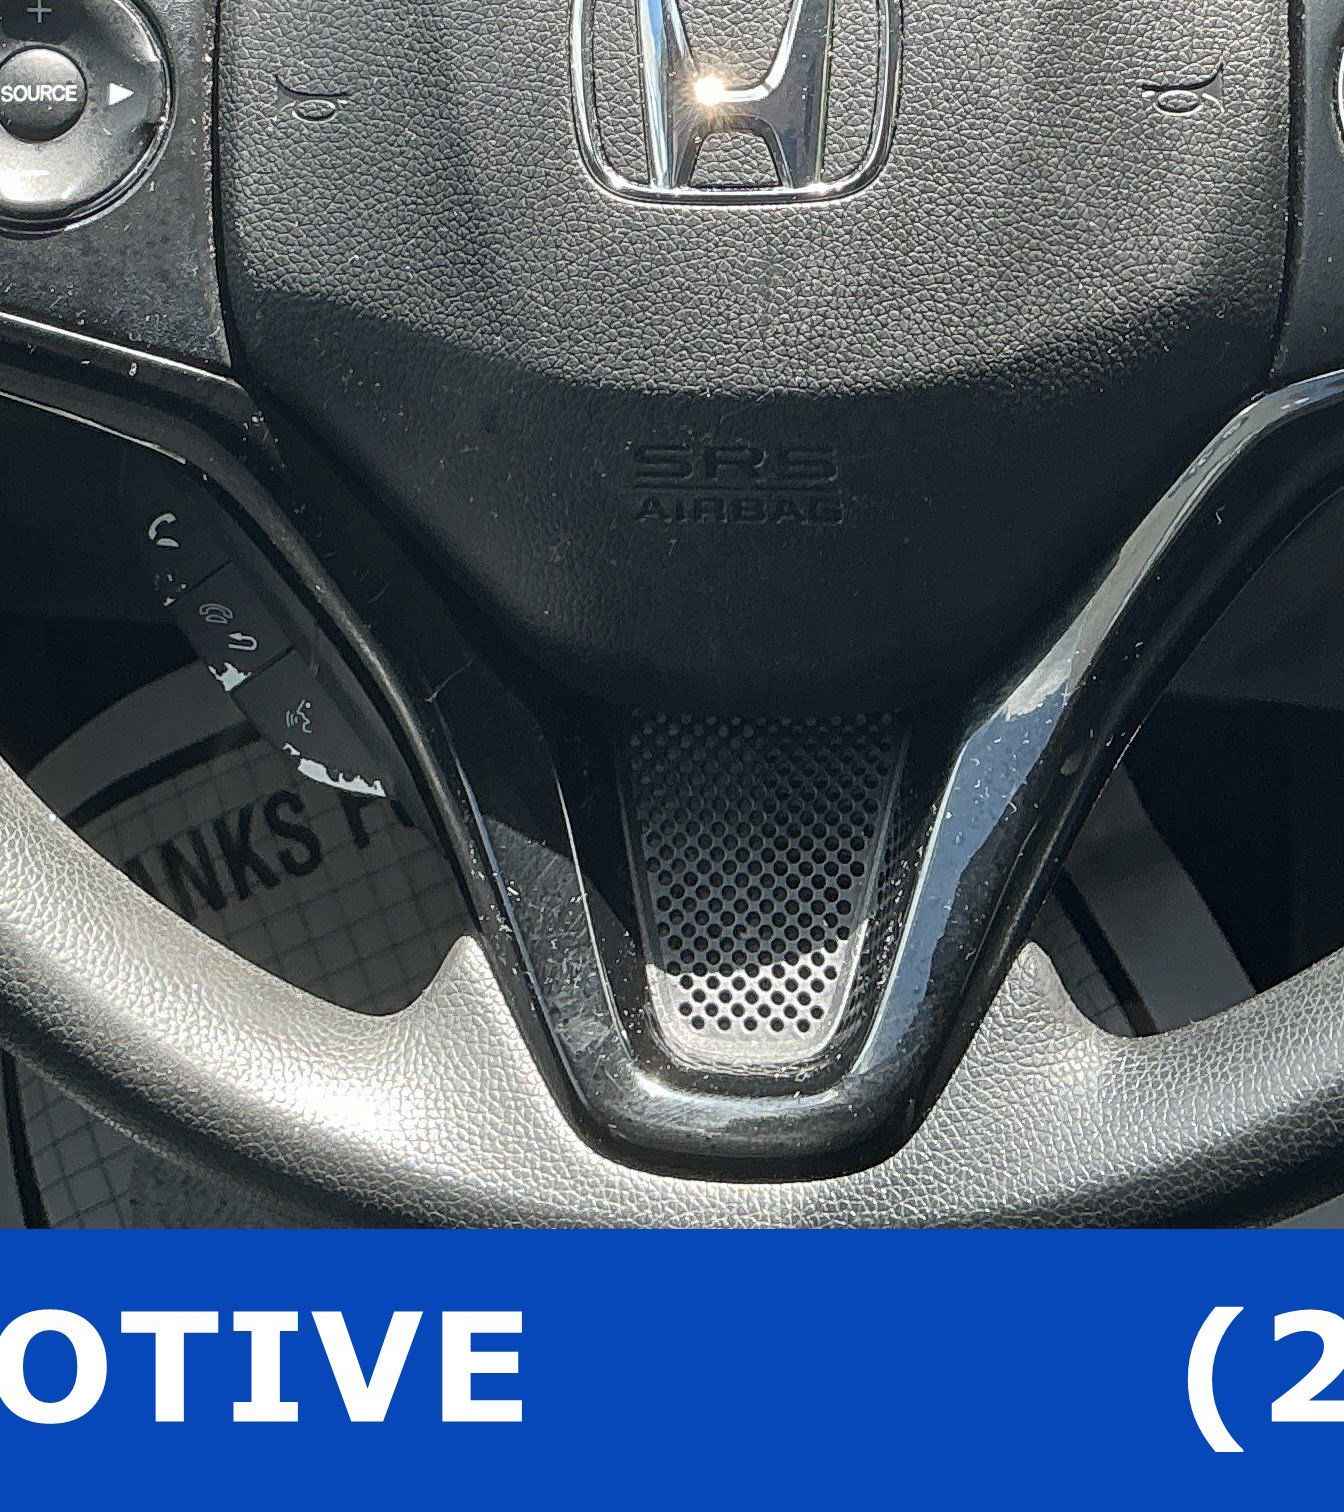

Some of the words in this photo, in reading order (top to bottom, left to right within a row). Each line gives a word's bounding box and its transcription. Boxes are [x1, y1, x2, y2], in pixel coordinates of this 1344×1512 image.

[0, 85, 78, 103] SOURCE
[632, 443, 840, 483] SRS
[635, 495, 846, 527] AIRBAG
